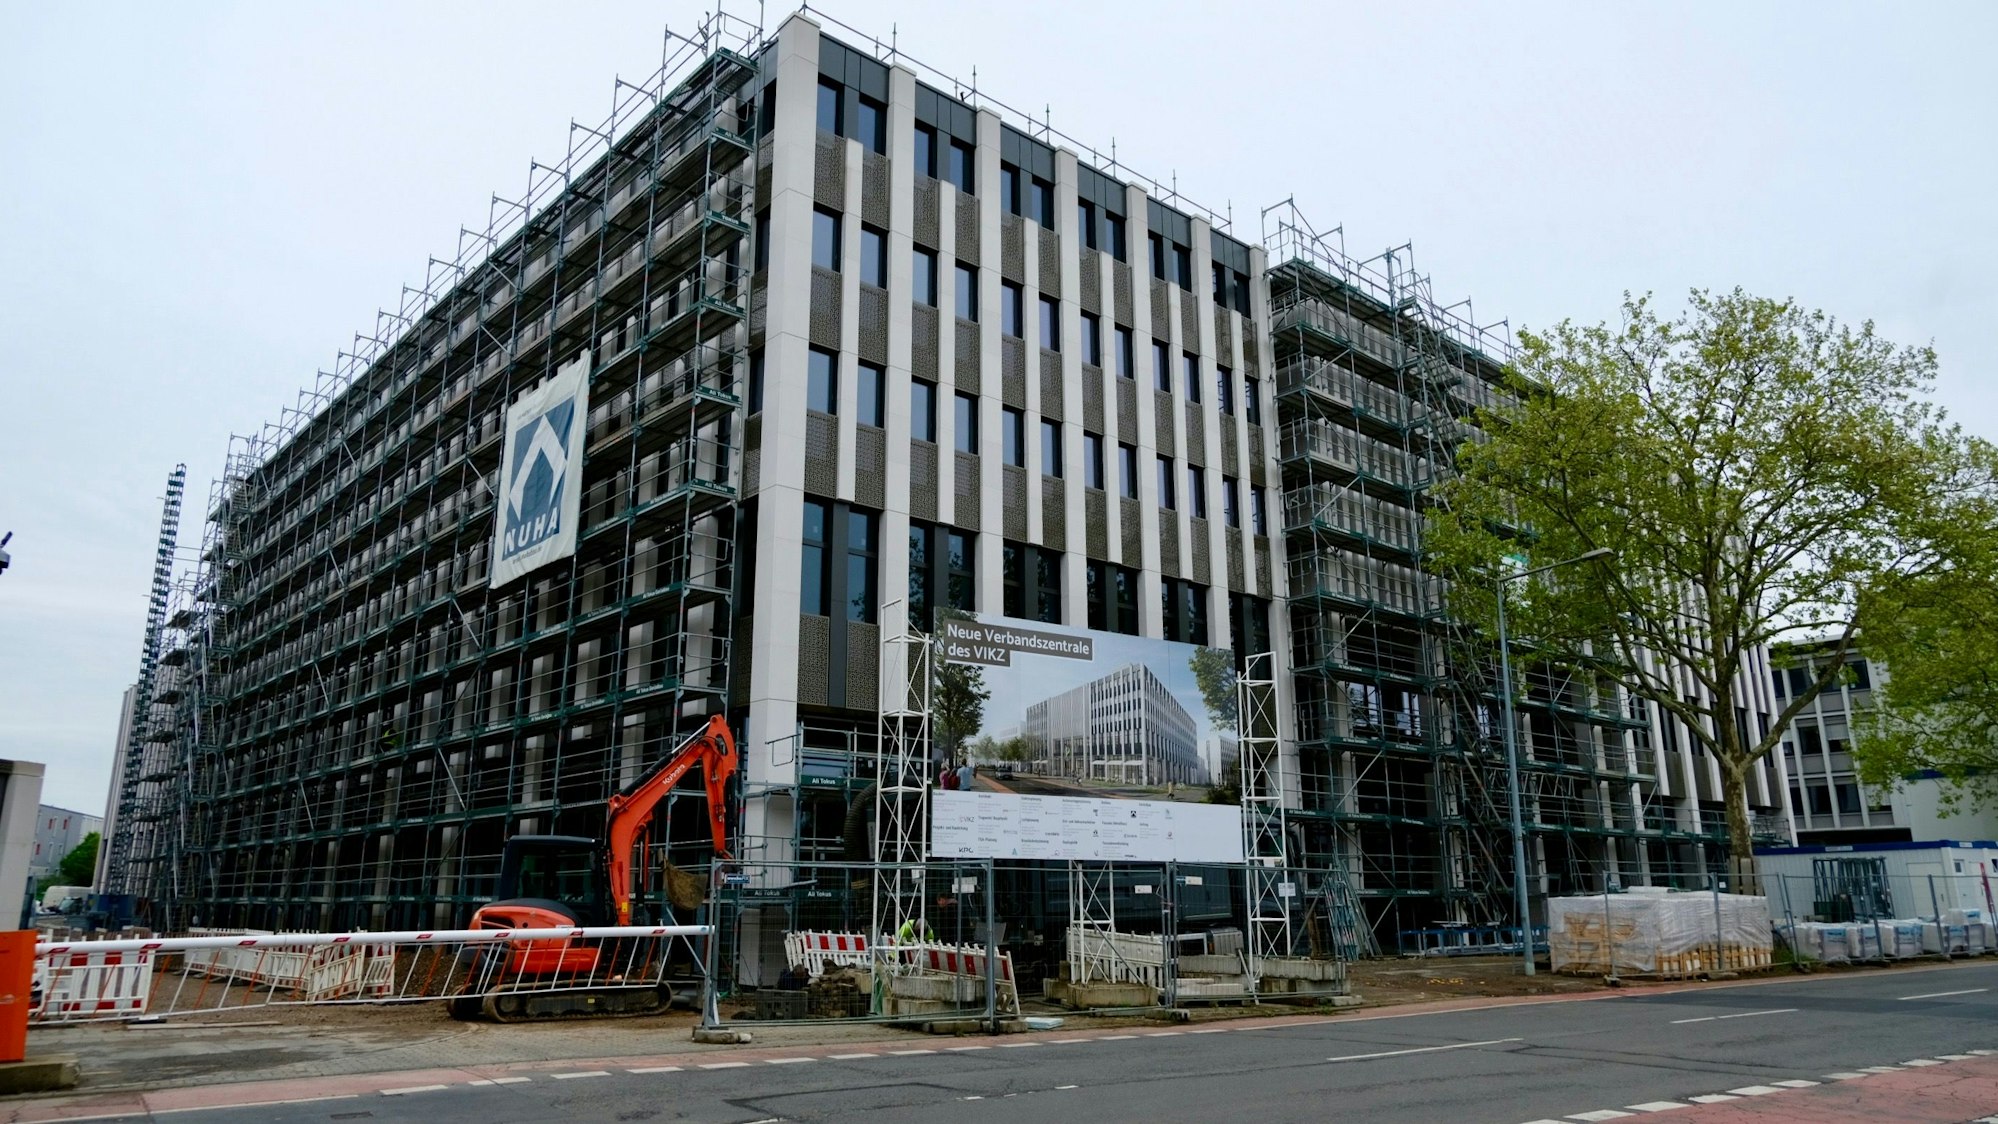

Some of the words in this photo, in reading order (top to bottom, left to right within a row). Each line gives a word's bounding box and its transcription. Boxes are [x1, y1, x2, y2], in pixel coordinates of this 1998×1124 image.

[504, 507, 559, 555] NUHA
[947, 623, 981, 641] Neue
[984, 629, 1090, 655] Verbandszentrale
[948, 643, 971, 658] des
[973, 645, 1006, 662] VIKZ
[662, 764, 685, 785] Kubota
